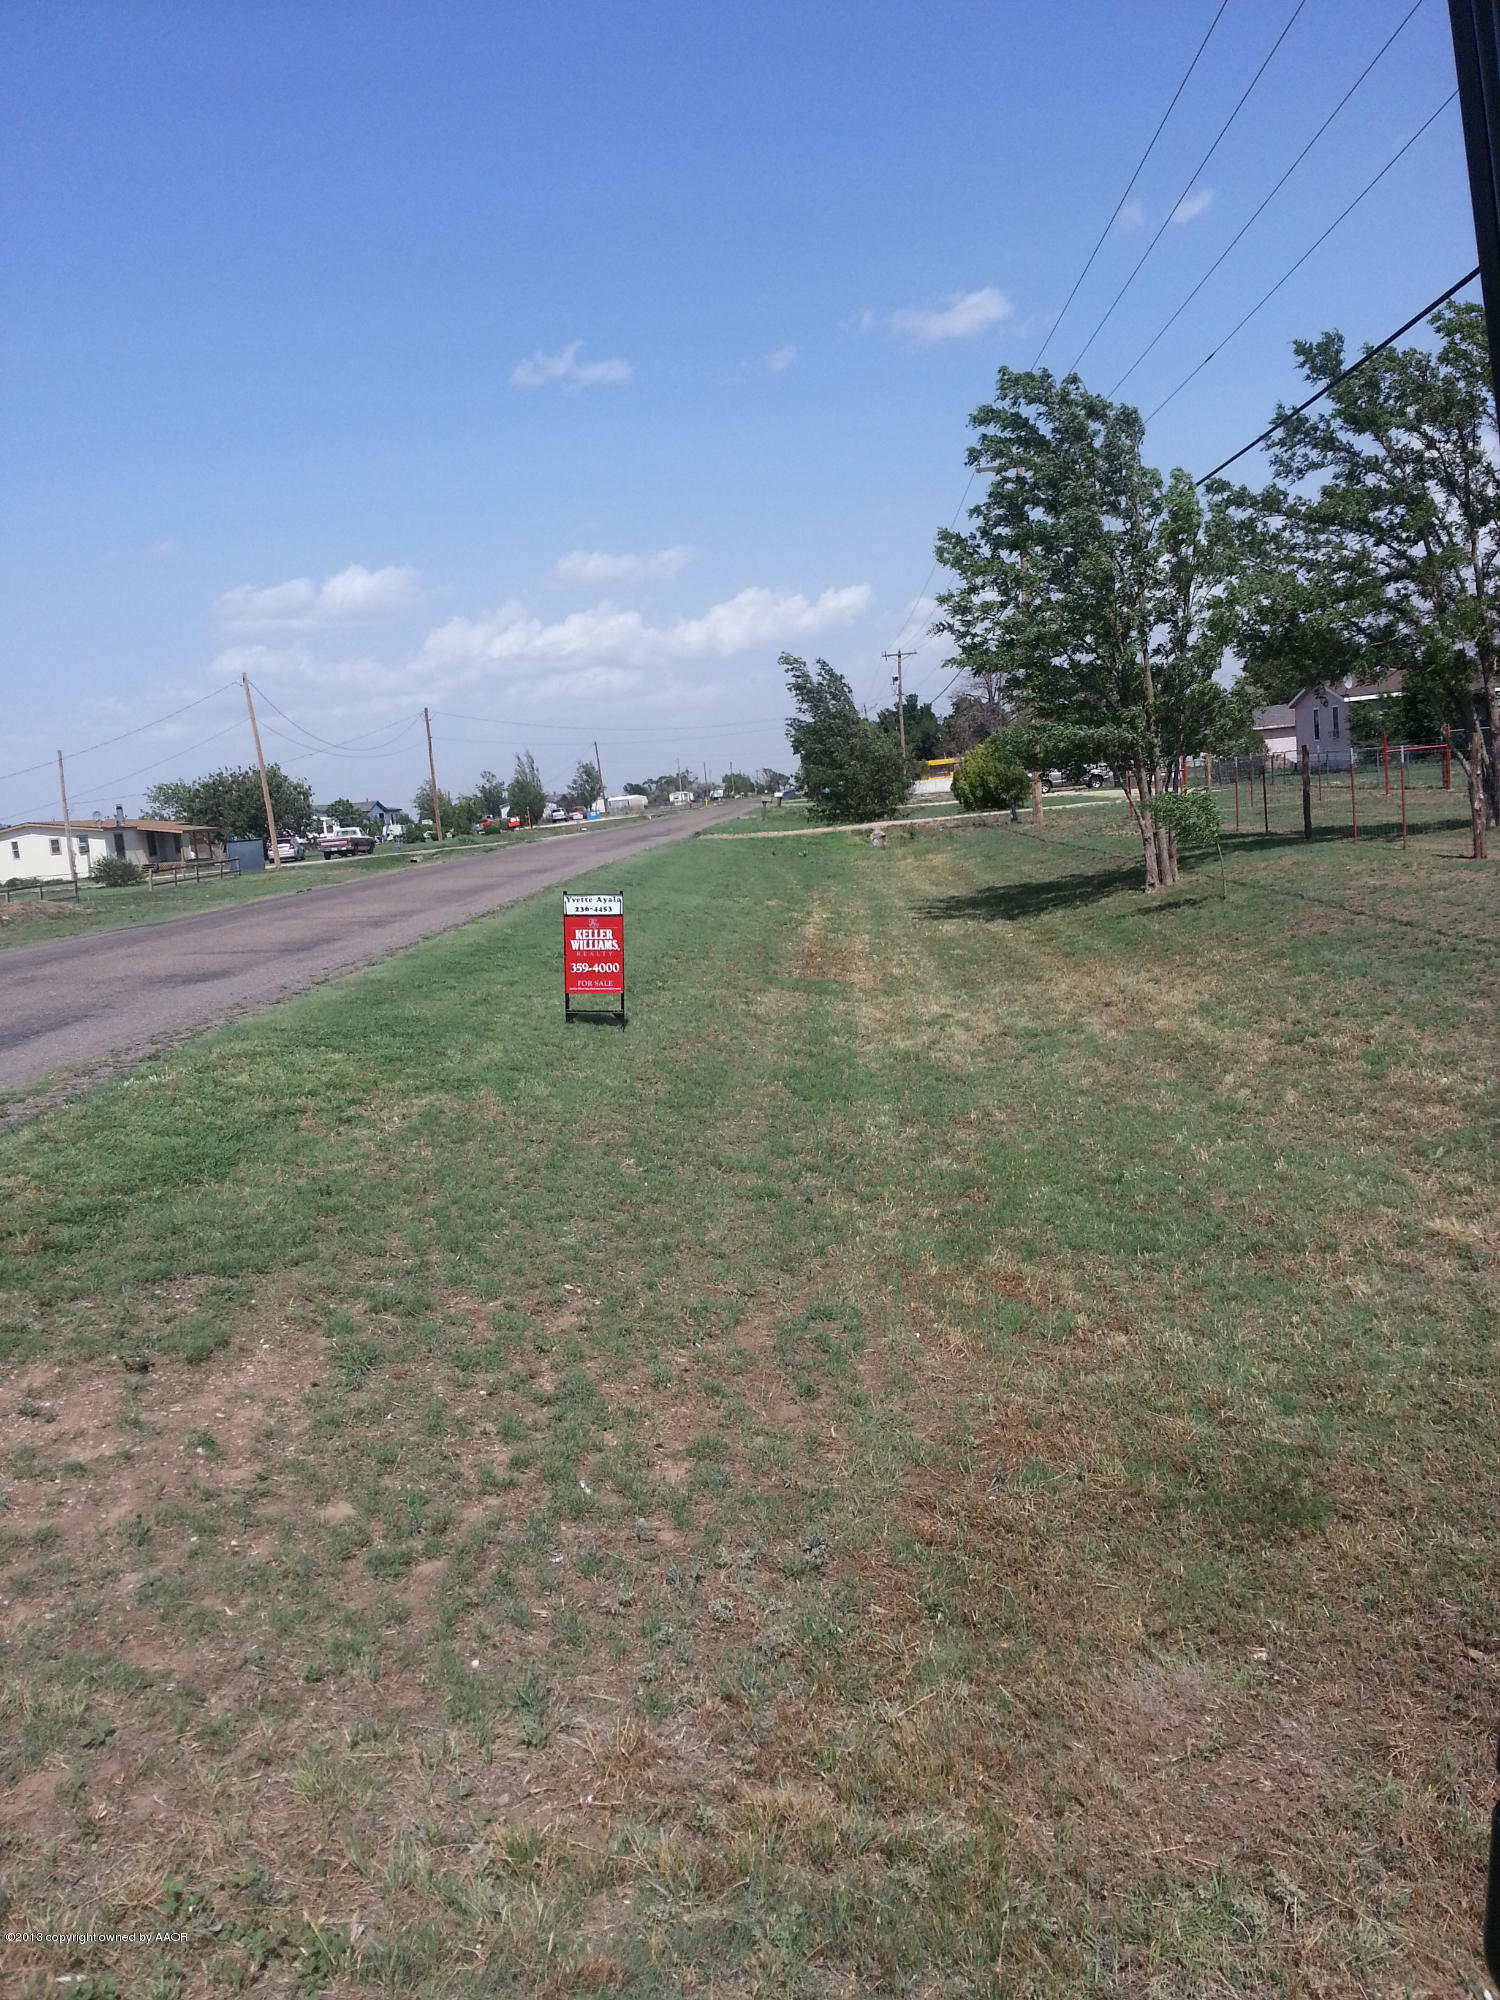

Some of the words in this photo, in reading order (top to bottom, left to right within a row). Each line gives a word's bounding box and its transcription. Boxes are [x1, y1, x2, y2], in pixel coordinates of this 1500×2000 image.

[596, 896, 621, 904] Ayala
[575, 929, 613, 940] KELLER
[570, 962, 620, 973] 359-4000
